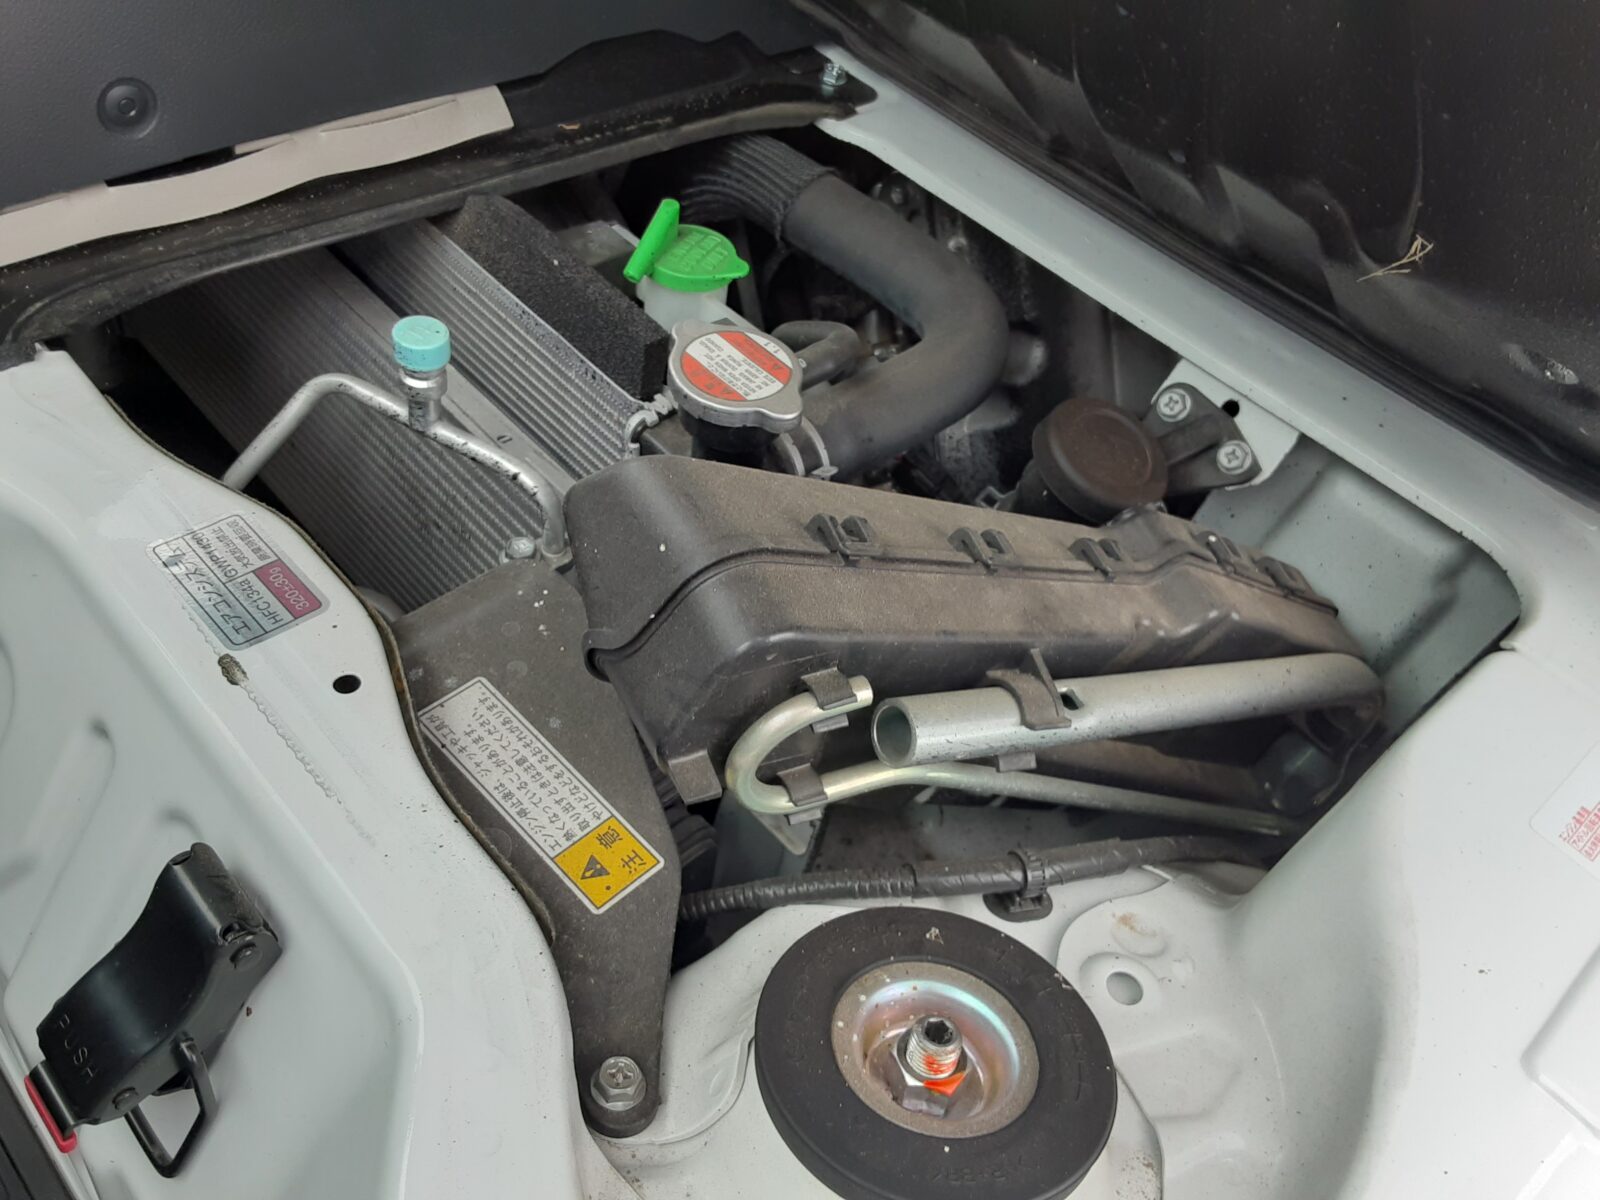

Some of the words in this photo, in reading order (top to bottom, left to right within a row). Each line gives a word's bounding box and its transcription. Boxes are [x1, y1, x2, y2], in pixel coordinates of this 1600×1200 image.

[192, 533, 237, 577] GWP1430
[239, 579, 282, 624] HFC134a
[269, 567, 309, 609] 320±30g
[596, 825, 646, 873] 注意
